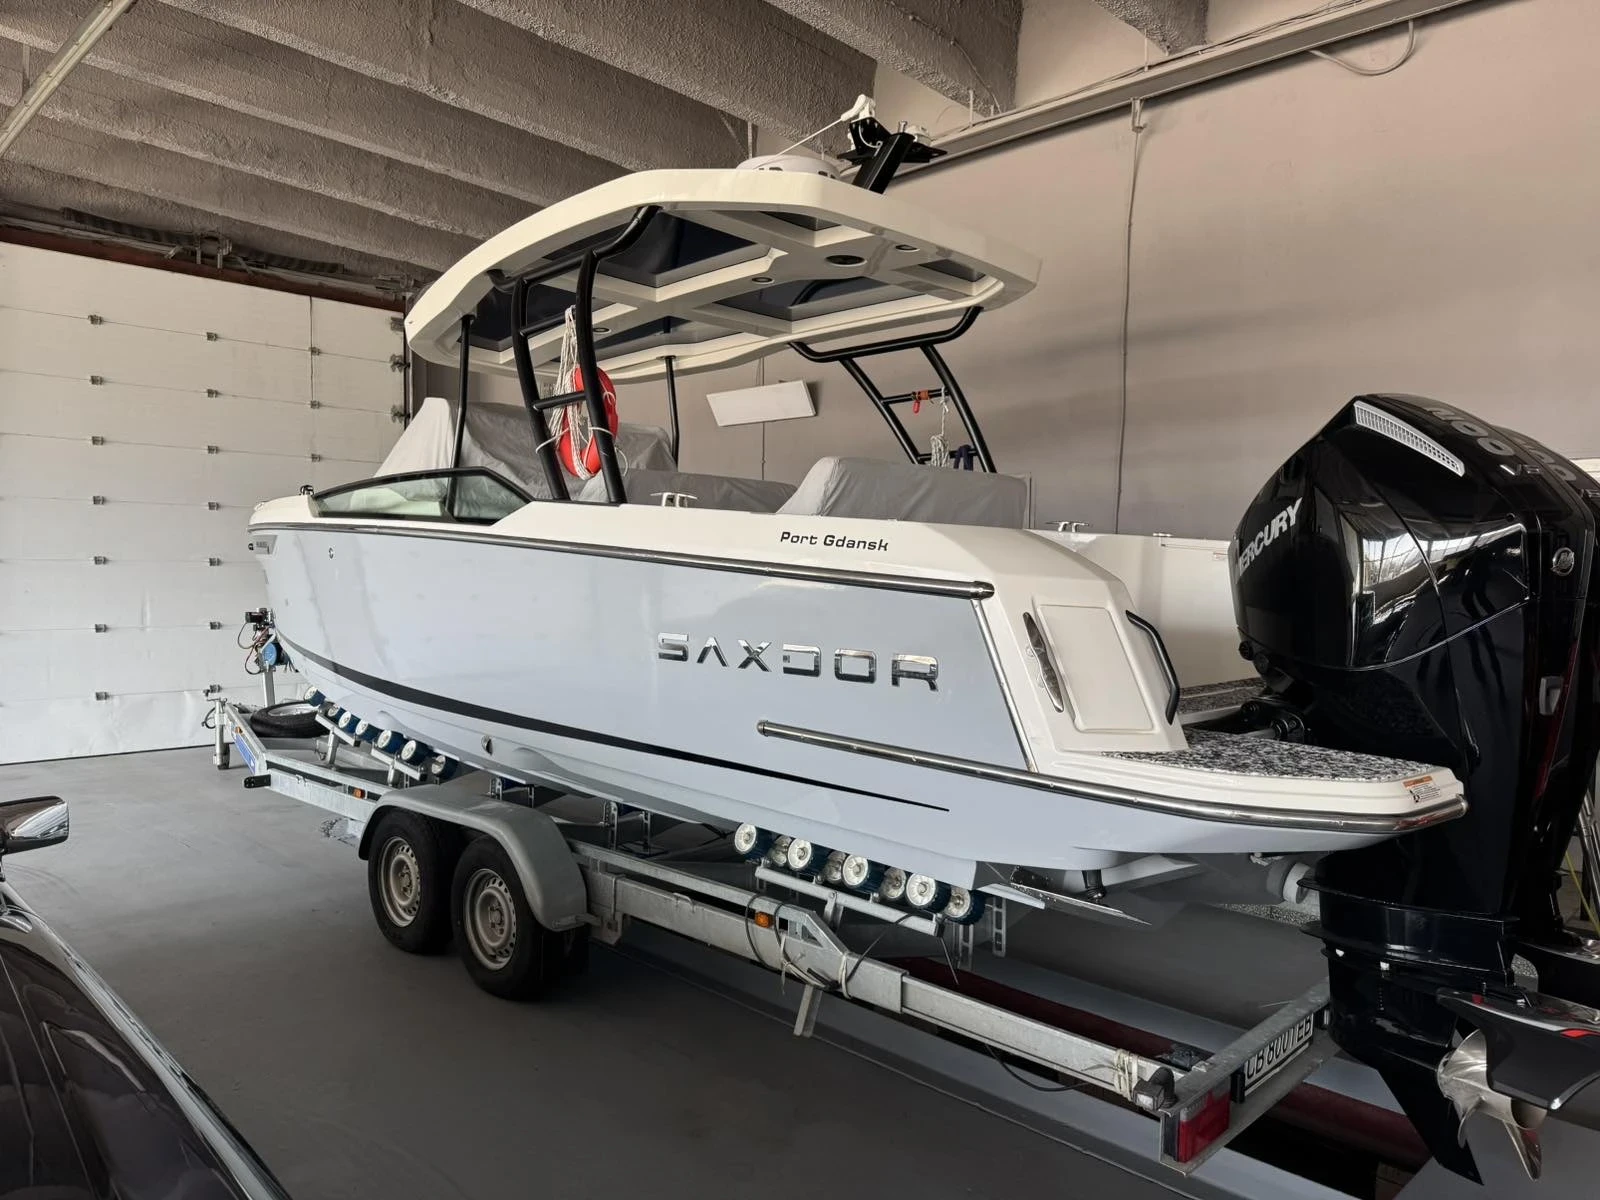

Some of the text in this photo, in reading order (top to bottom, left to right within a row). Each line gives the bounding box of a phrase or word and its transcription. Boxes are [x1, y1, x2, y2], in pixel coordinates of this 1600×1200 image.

[780, 531, 889, 552] Port Gdansk
[657, 631, 939, 692] SAXDOR
